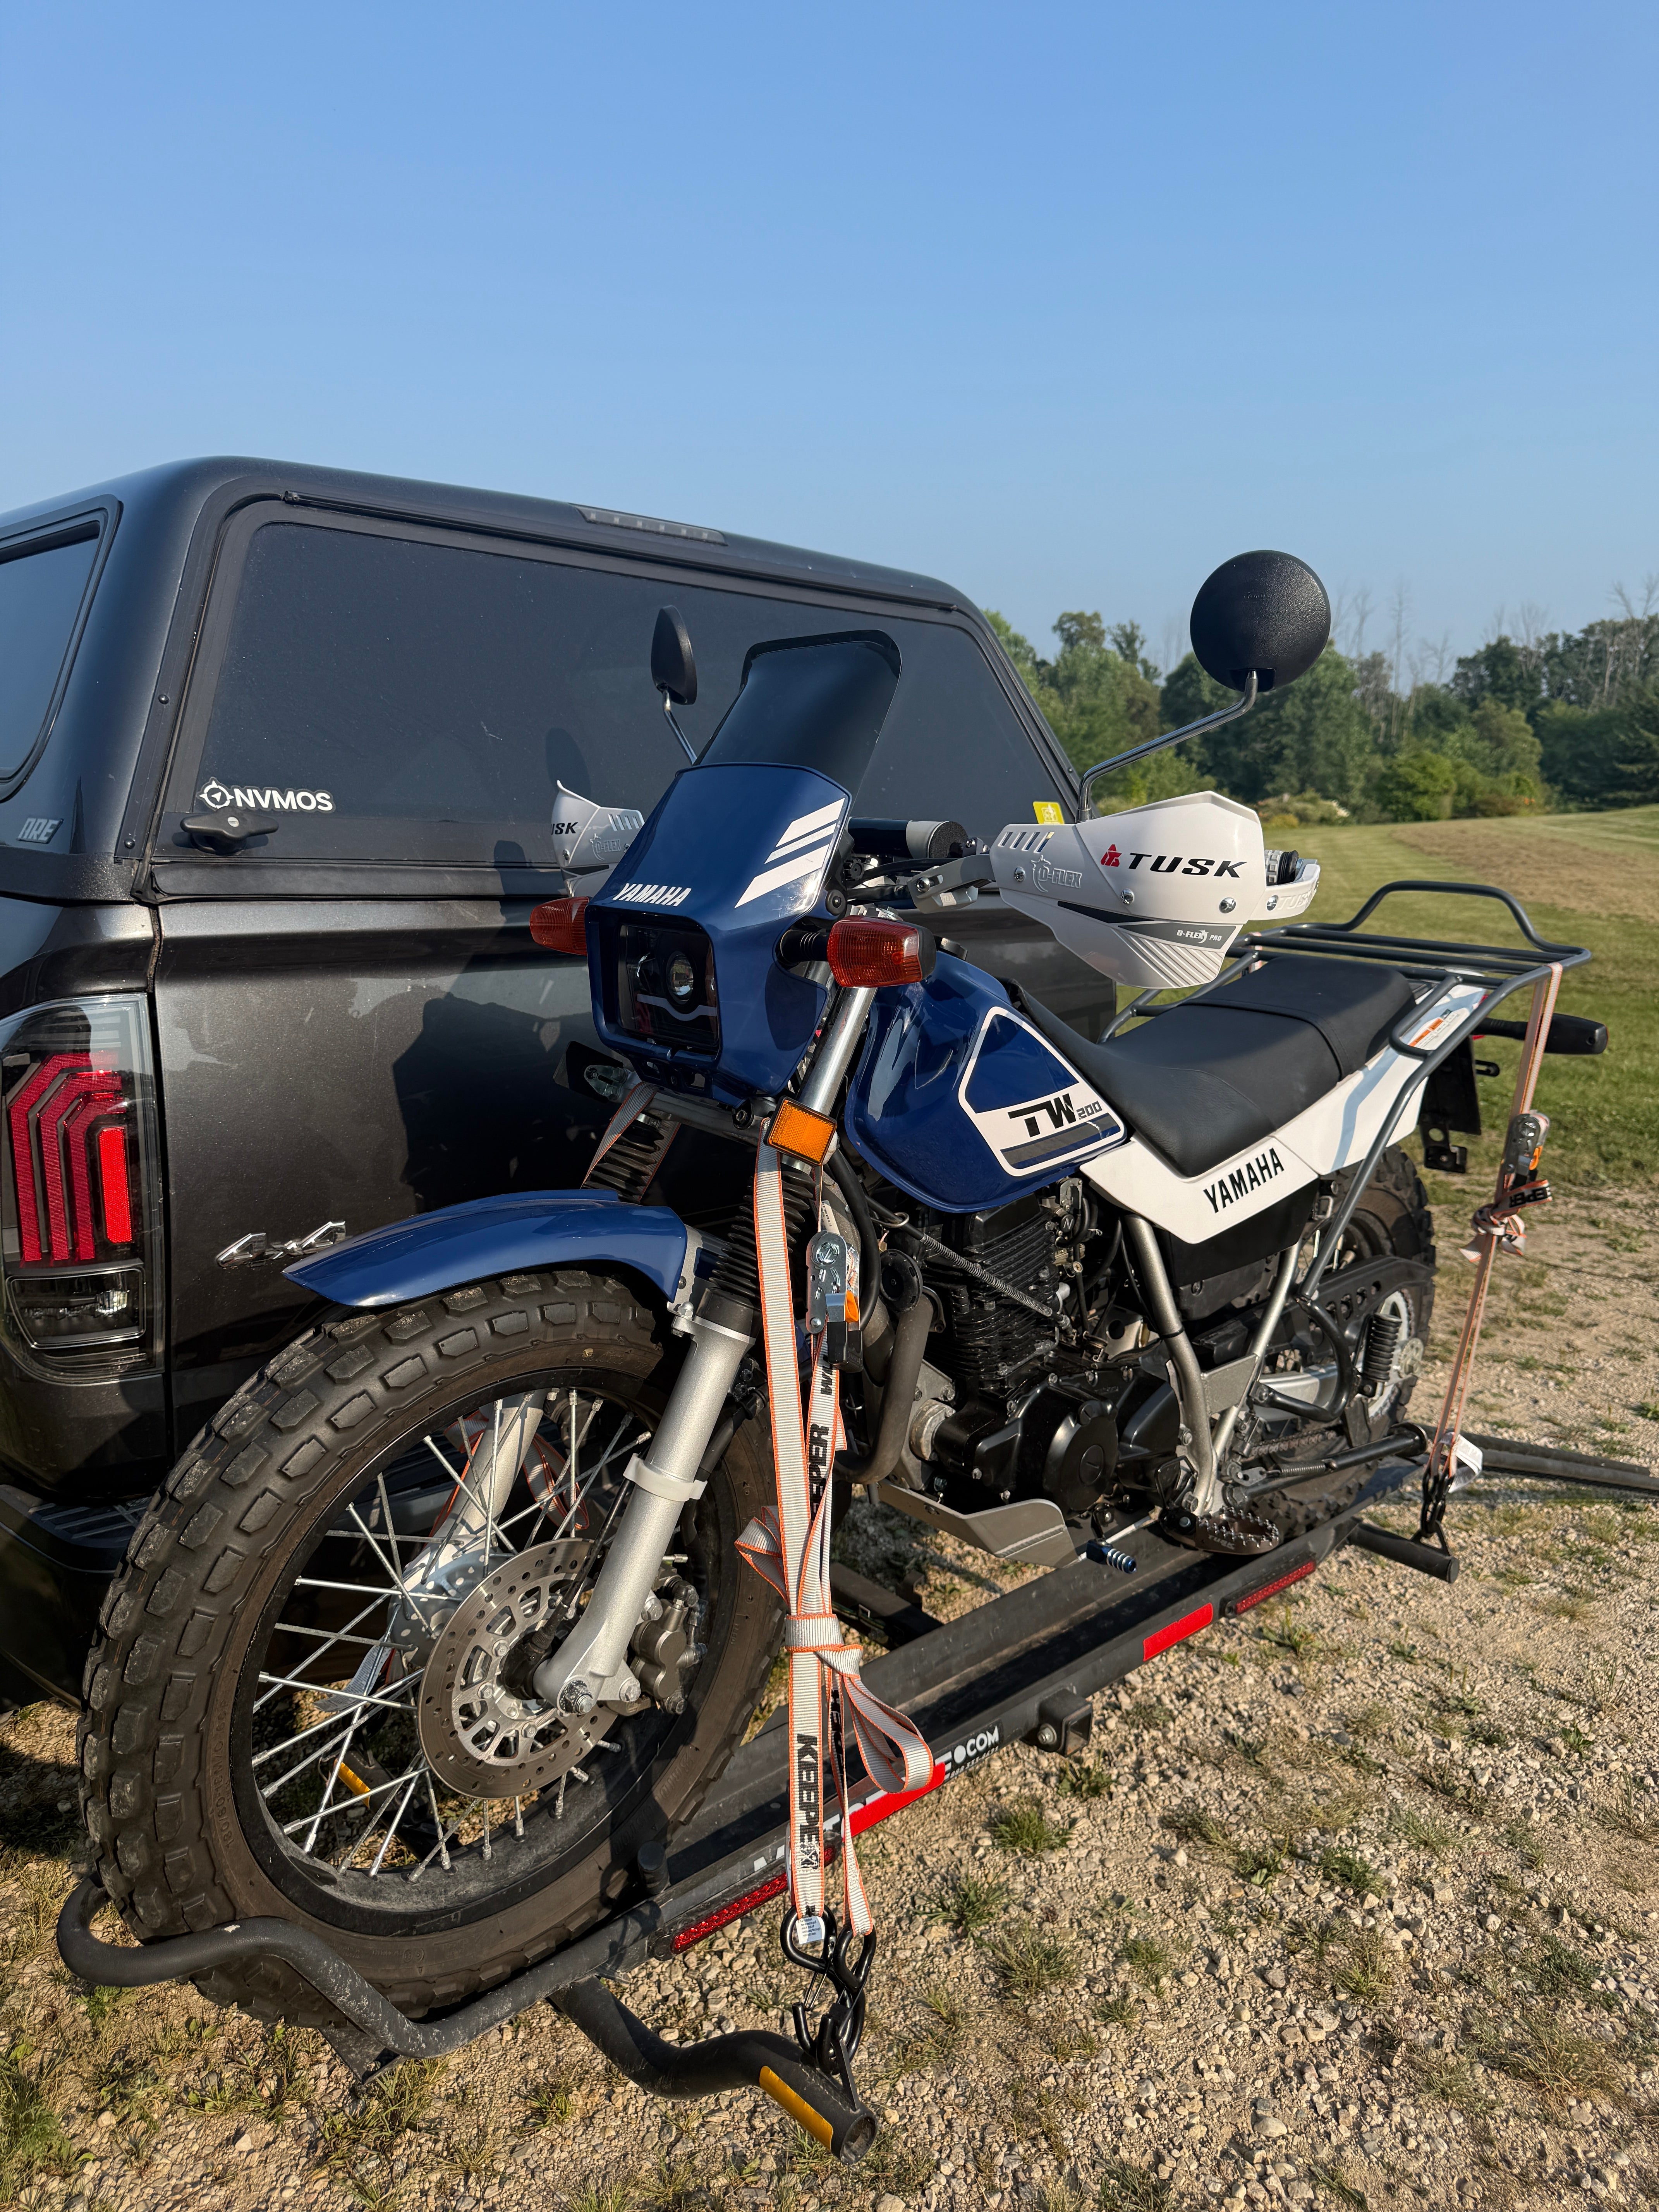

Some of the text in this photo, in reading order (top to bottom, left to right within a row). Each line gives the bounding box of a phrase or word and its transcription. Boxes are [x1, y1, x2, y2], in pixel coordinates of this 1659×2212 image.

[234, 788, 333, 811] NVMOS
[18, 817, 59, 841] ARE
[596, 839, 622, 853] D-FLEX
[1128, 852, 1247, 878] TUSK
[1038, 867, 1082, 889] D-FLEX
[612, 883, 692, 907] YAMAHA
[1008, 1093, 1103, 1137] TW 200
[1203, 1147, 1285, 1213] YAMAHA
